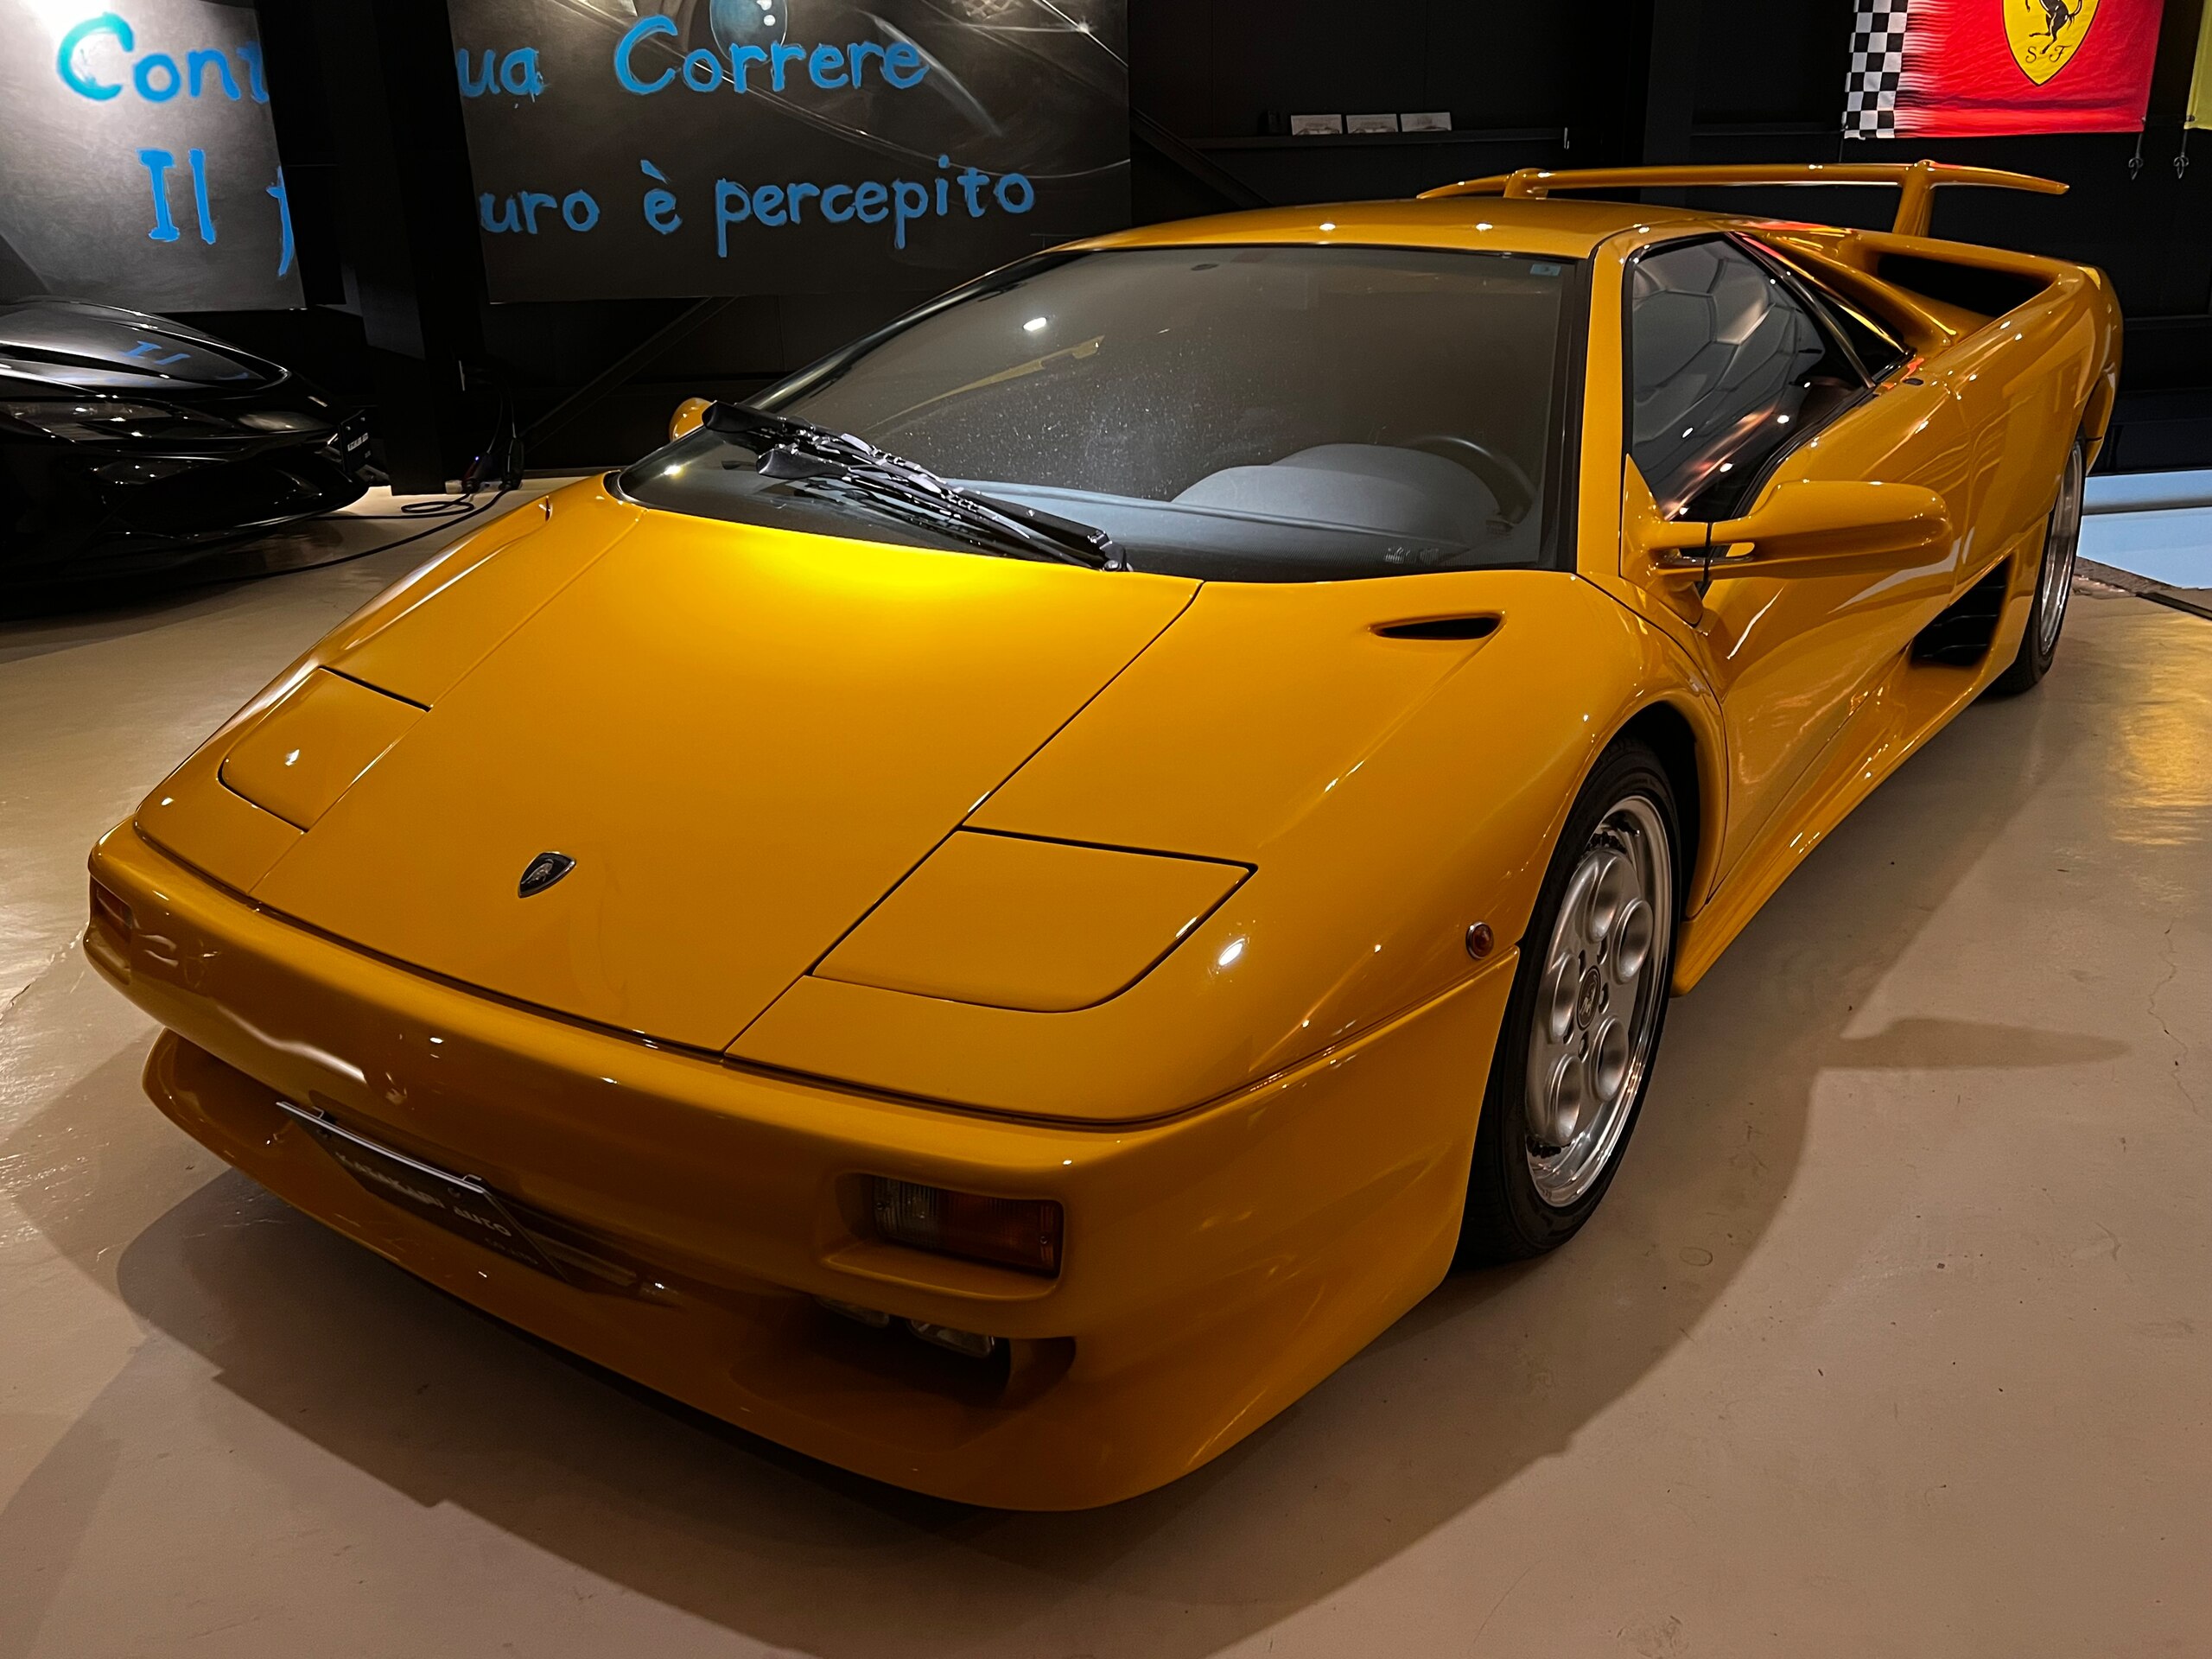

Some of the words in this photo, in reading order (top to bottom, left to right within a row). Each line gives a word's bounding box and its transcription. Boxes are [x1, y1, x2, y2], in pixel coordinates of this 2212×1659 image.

[613, 15, 929, 95] Correre
[136, 147, 217, 245] Il
[640, 159, 683, 234] è
[715, 154, 1034, 257] percepito
